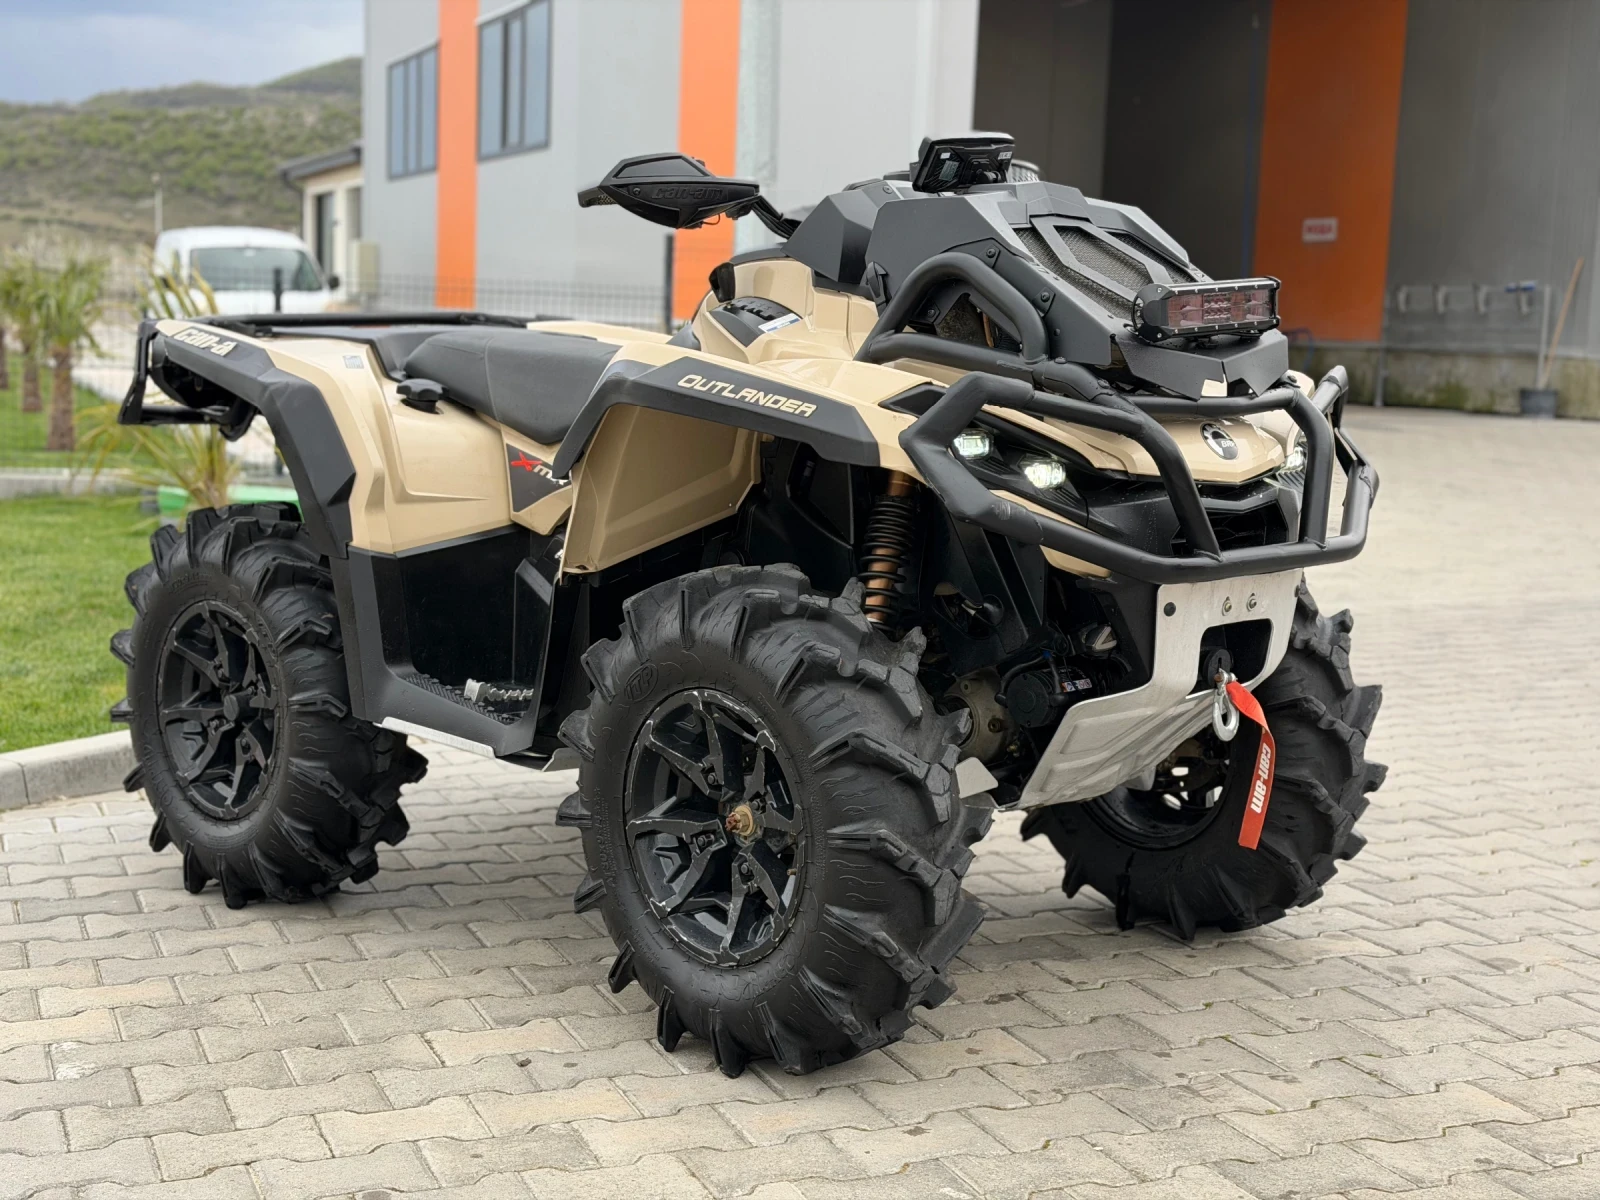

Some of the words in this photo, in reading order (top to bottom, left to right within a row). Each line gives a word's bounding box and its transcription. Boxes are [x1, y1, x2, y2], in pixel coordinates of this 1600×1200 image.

[652, 186, 724, 200] can-am
[677, 374, 817, 417] OUTLANDER
[626, 665, 653, 700] ITP
[1250, 742, 1272, 814] can-am
